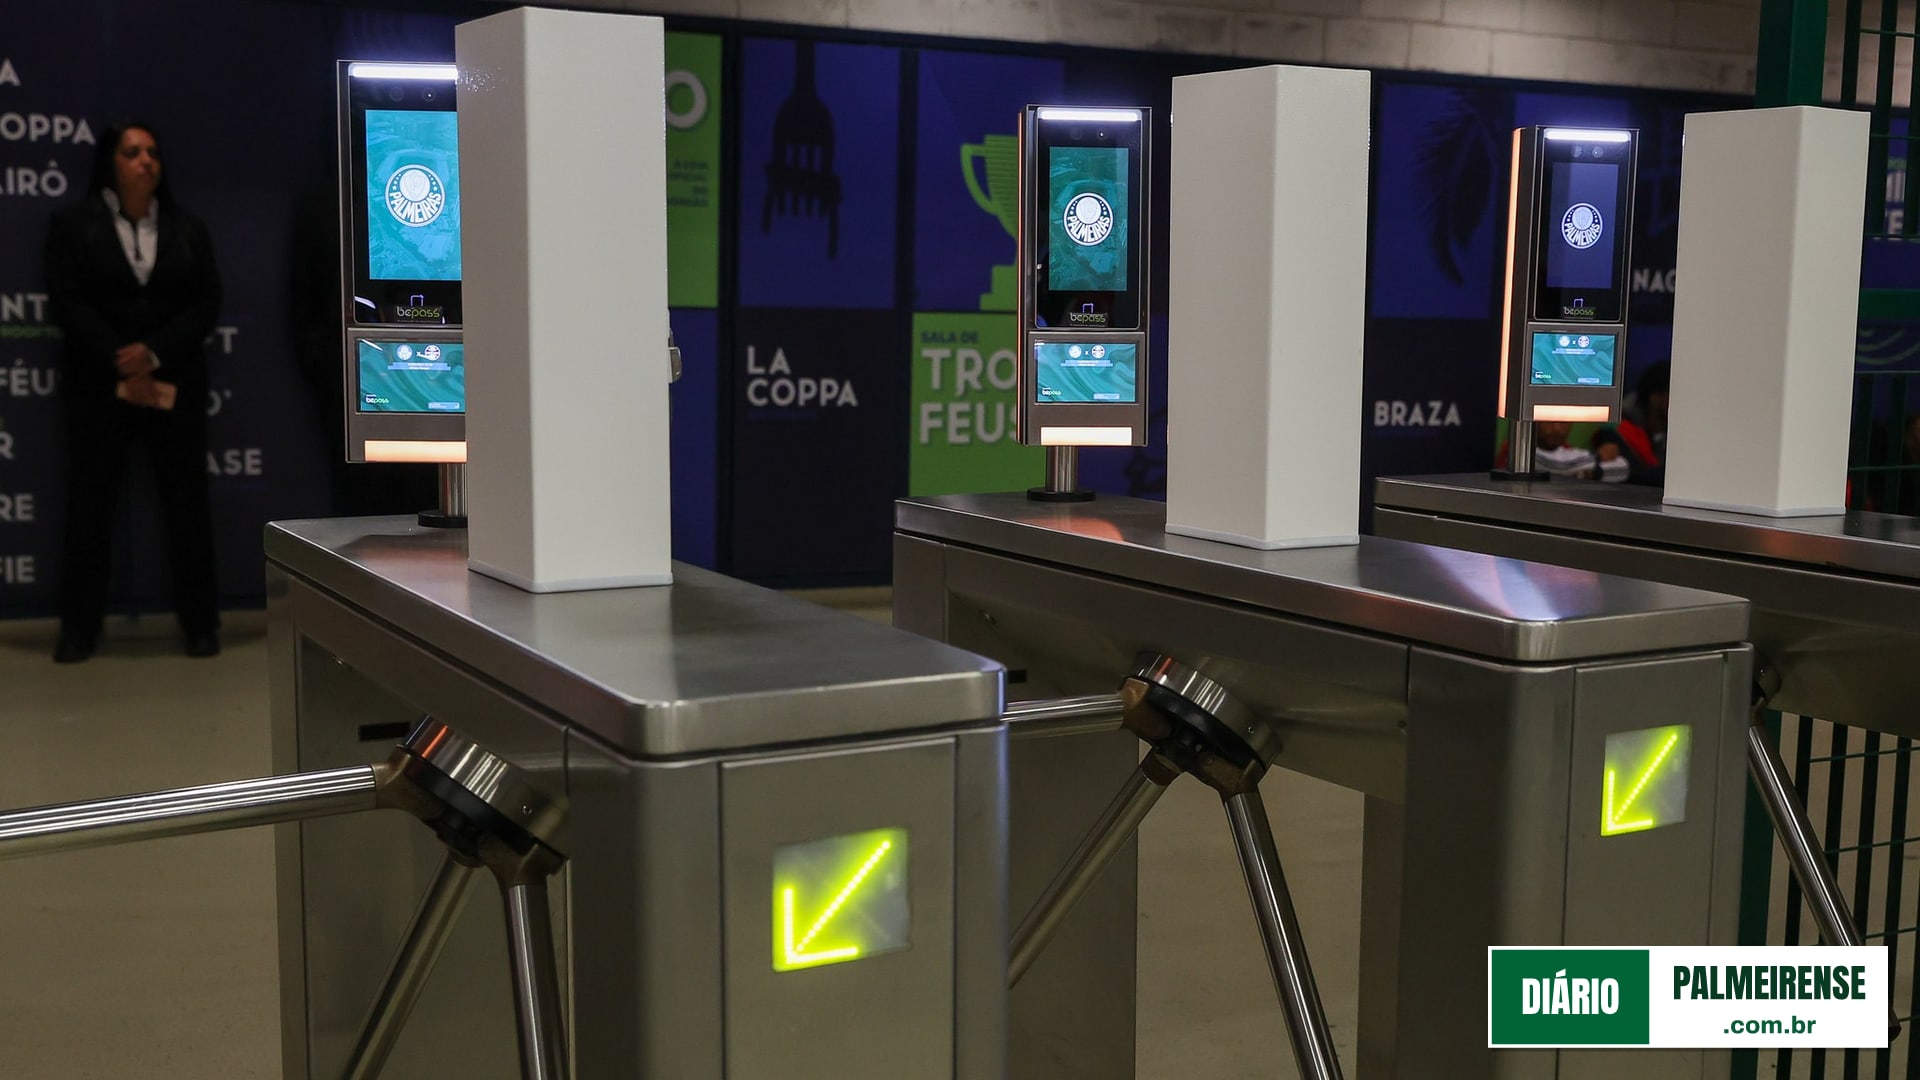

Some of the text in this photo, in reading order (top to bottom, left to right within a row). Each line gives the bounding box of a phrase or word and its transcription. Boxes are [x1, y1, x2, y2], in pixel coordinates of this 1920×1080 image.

[0, 112, 96, 145] OPPA
[0, 160, 68, 197] IRÔ
[390, 192, 441, 223] PALMEIRAS
[1067, 216, 1110, 242] PALMEIRAS
[1564, 223, 1600, 245] PALMEIRAS
[397, 306, 440, 319] bepass
[1070, 313, 1106, 323] bepass
[1564, 307, 1594, 316] bepass
[747, 344, 791, 374] LA
[921, 348, 1017, 396] TRO
[747, 377, 859, 407] COPPA
[1373, 399, 1461, 427] BRAZA
[0, 555, 35, 584] IE
